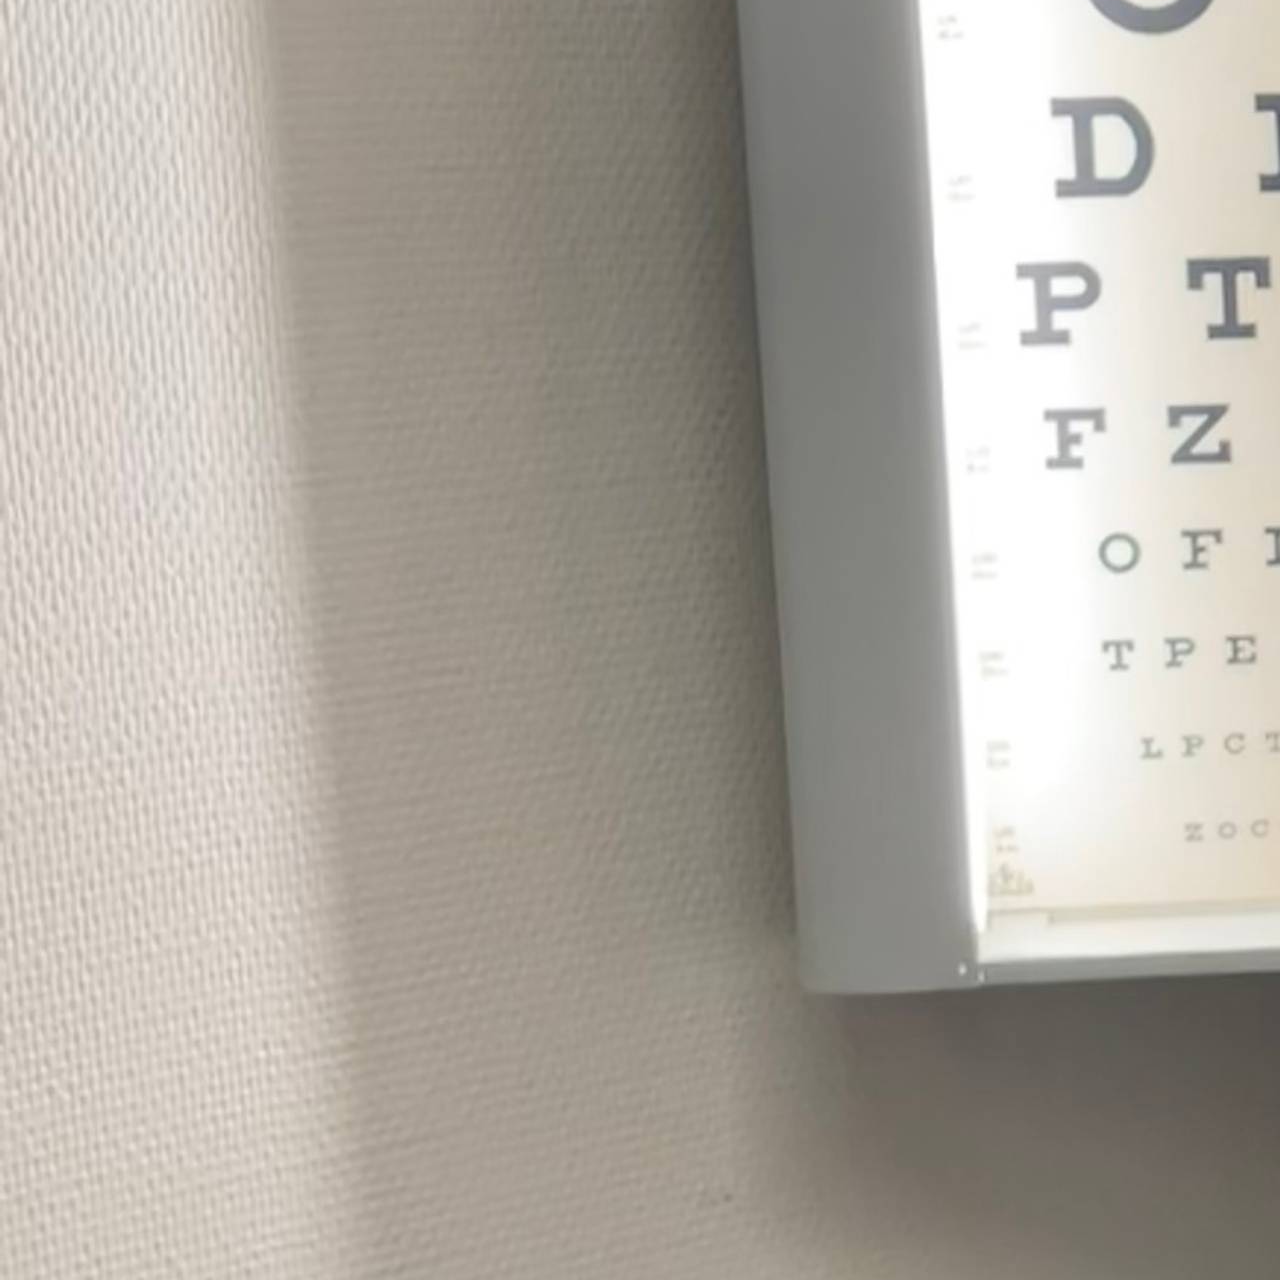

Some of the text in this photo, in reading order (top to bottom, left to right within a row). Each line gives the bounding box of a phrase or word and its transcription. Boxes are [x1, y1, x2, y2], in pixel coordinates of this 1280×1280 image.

[1051, 97, 1154, 198] D
[1016, 262, 1101, 345] P
[1187, 257, 1271, 340] T
[1044, 409, 1105, 469] F
[1168, 405, 1231, 464] Z
[1099, 534, 1140, 573] O
[1182, 530, 1222, 569] F
[1103, 641, 1133, 670] T
[1166, 639, 1194, 667] P
[1227, 637, 1256, 664] E
